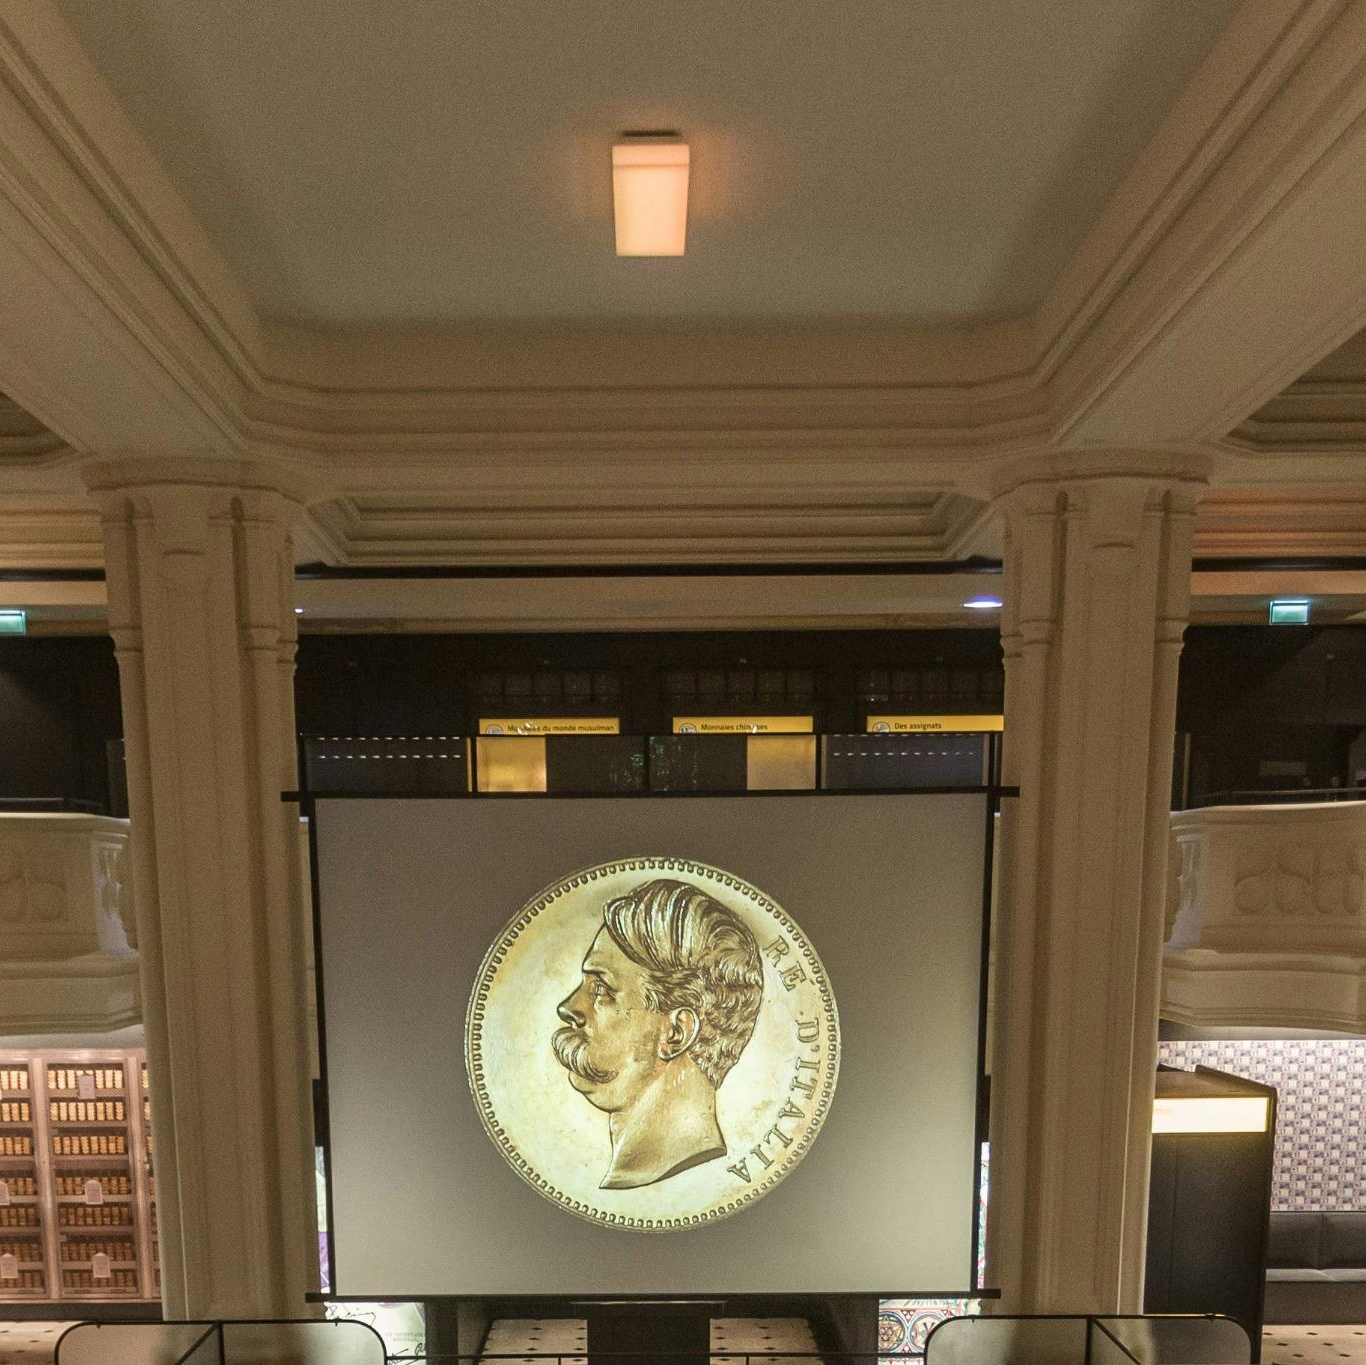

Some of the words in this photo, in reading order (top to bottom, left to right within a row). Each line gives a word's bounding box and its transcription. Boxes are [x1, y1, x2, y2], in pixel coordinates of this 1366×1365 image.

[542, 724, 551, 732] du
[553, 724, 576, 732] monde
[578, 724, 614, 732] musulman
[700, 723, 734, 731] Monnaies
[894, 722, 907, 730] Des
[909, 723, 942, 731] assignats
[762, 934, 807, 992] RE
[726, 1017, 821, 1183] D'ITALIA
